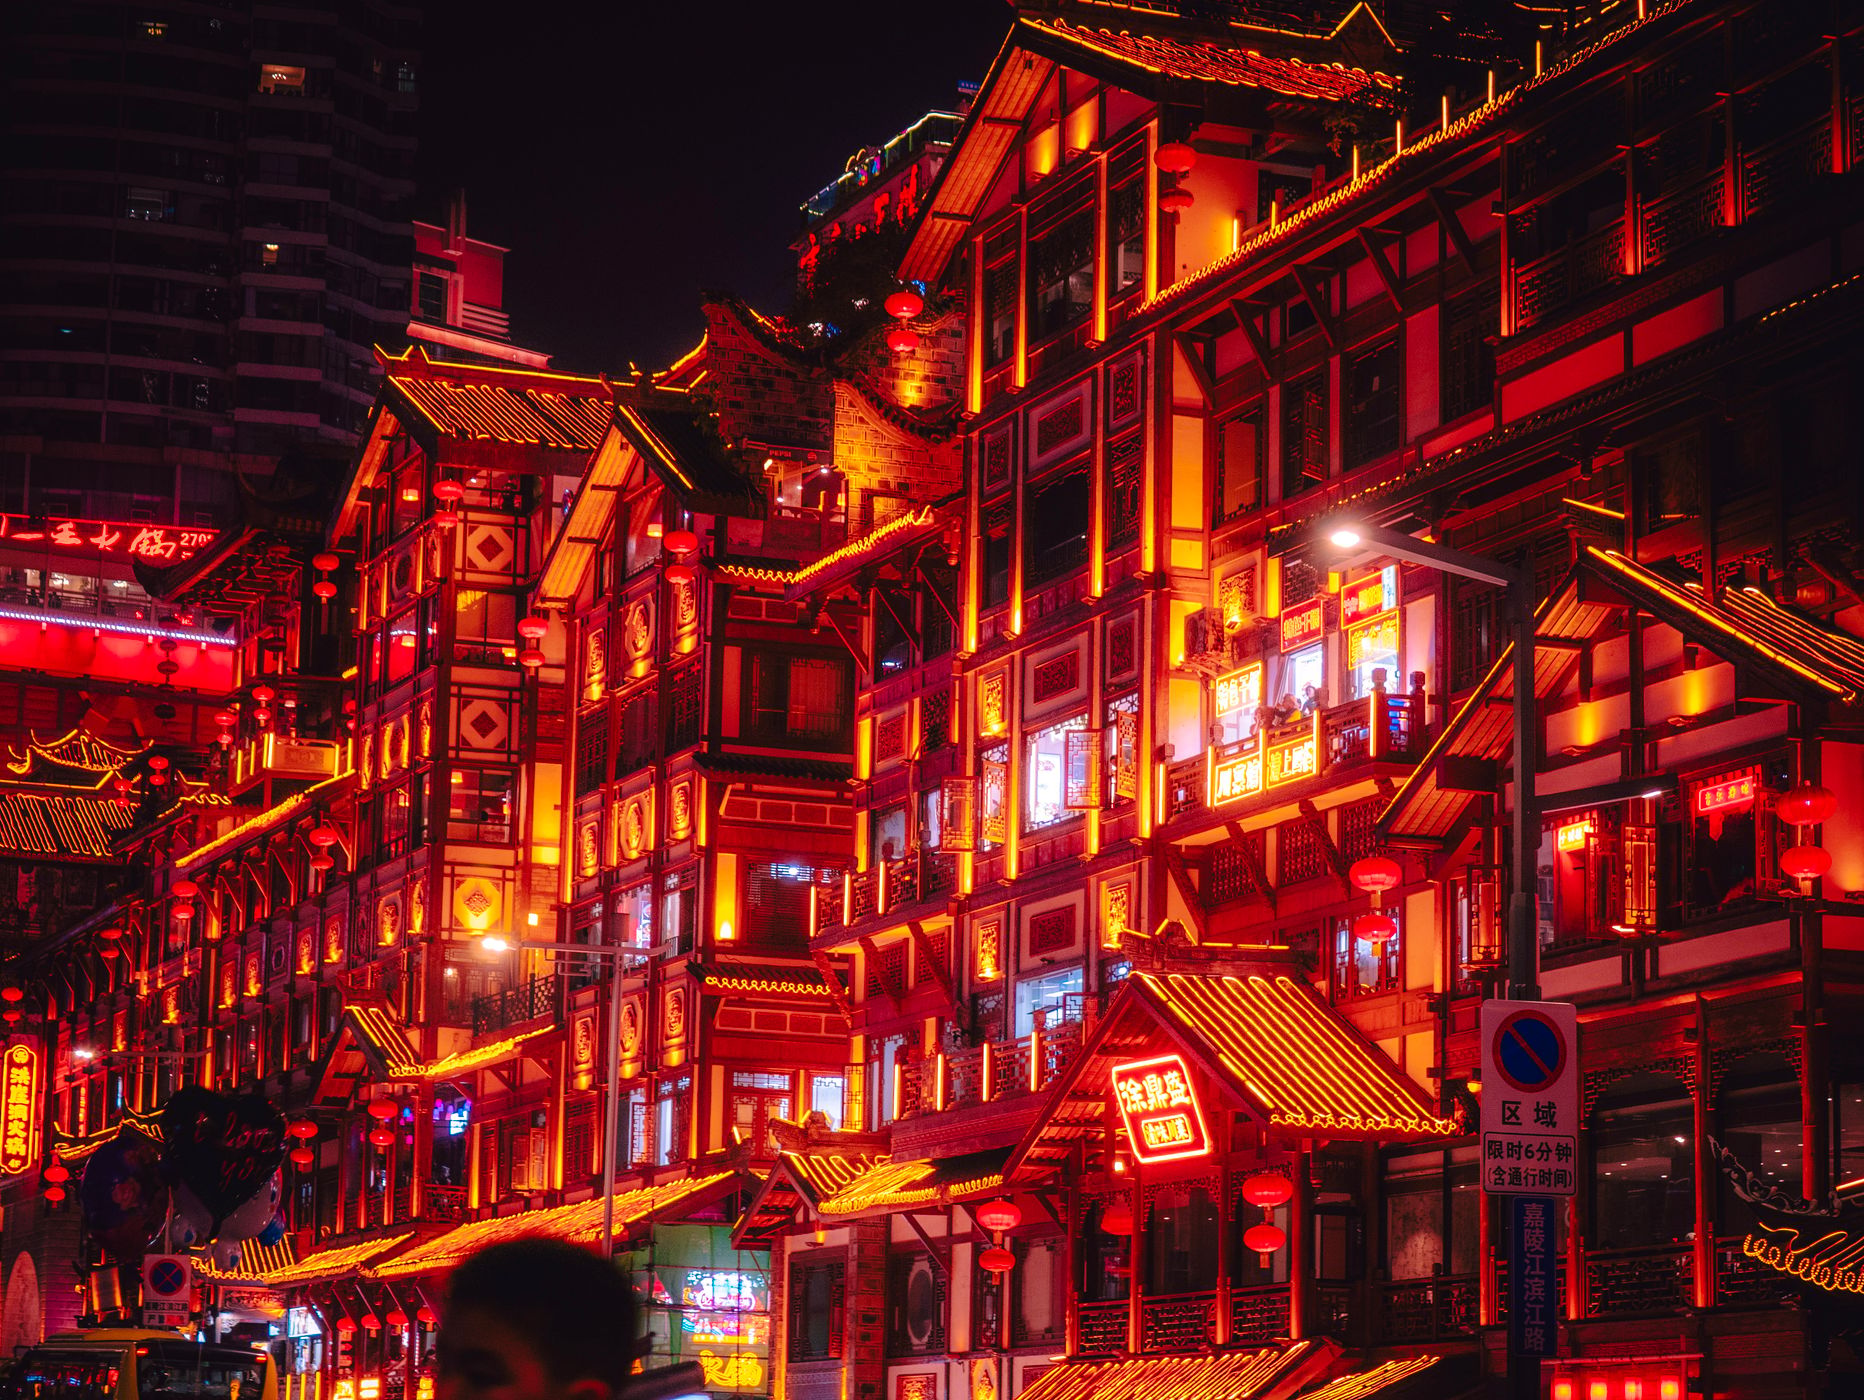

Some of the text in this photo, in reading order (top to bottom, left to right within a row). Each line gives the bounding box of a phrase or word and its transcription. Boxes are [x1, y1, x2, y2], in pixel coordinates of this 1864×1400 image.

[0, 516, 176, 557] 一手火锅
[1501, 1100, 1558, 1128] 区域
[1487, 1139, 1573, 1163] 限时6分钟
[1487, 1165, 1573, 1189] (含通行时间)
[1523, 1203, 1546, 1352] 嘉陵江滨江路
